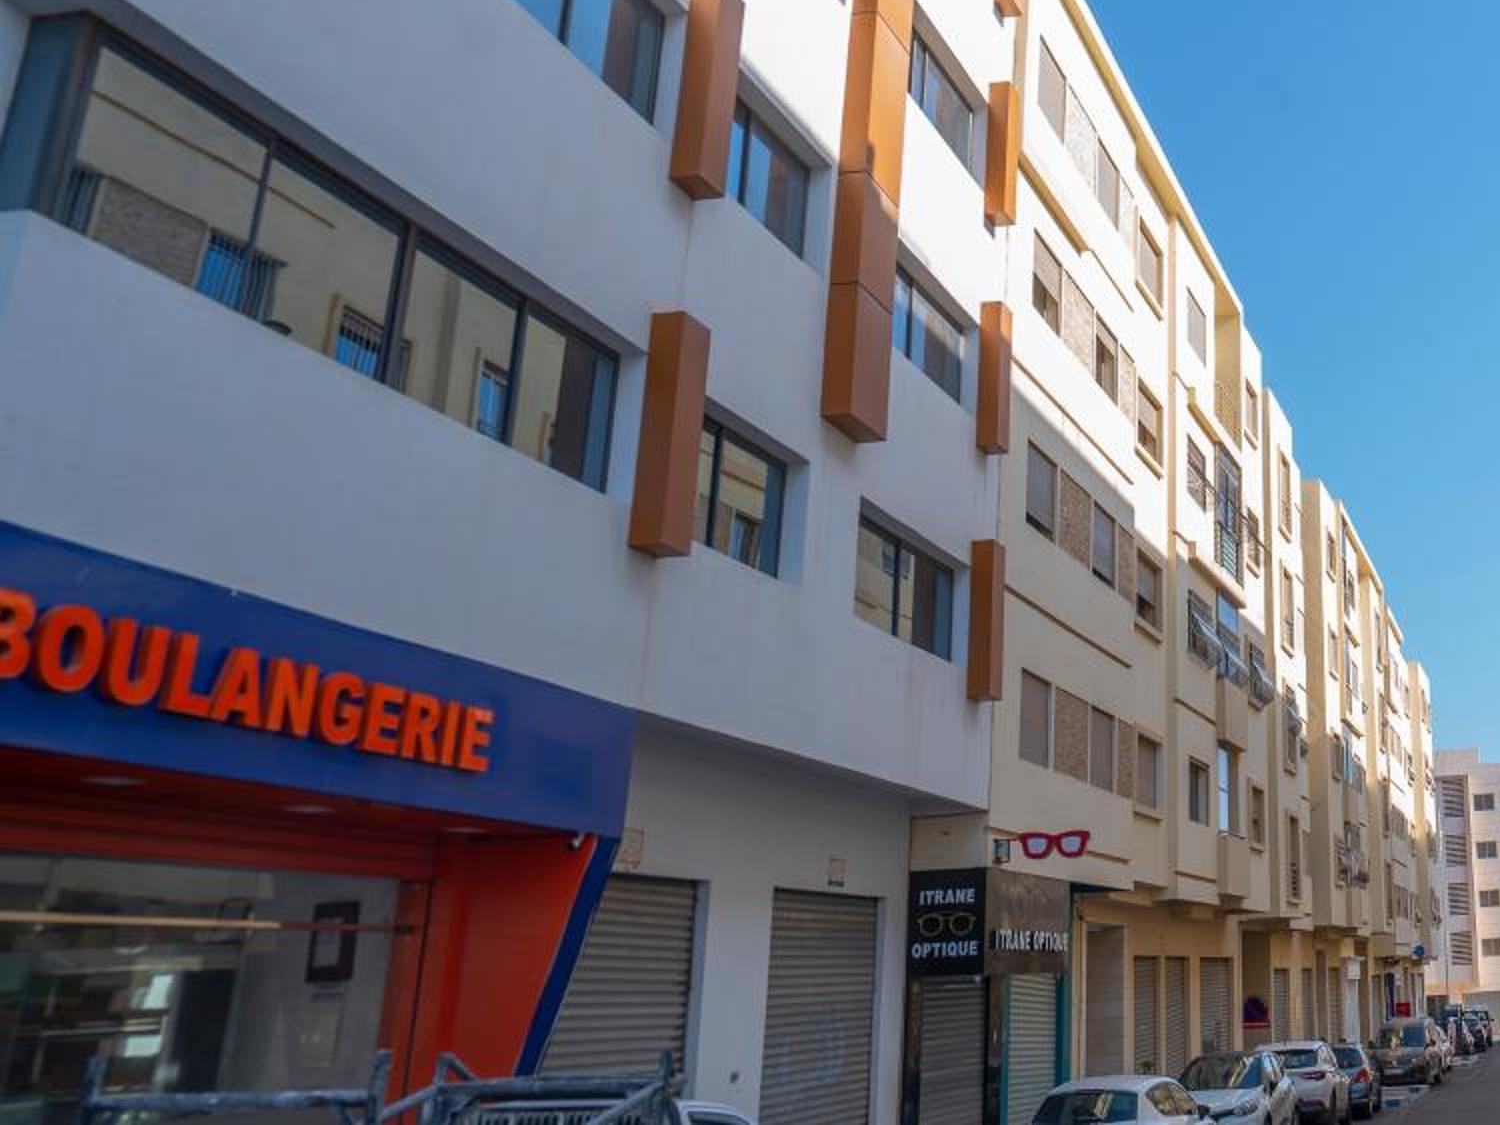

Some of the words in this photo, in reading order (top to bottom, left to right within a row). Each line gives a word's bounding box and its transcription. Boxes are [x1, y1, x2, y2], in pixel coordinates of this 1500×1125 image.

[0, 588, 495, 774] BOULANGERIE
[919, 888, 976, 906] ITRANE
[911, 940, 978, 959] OPTIQUE
